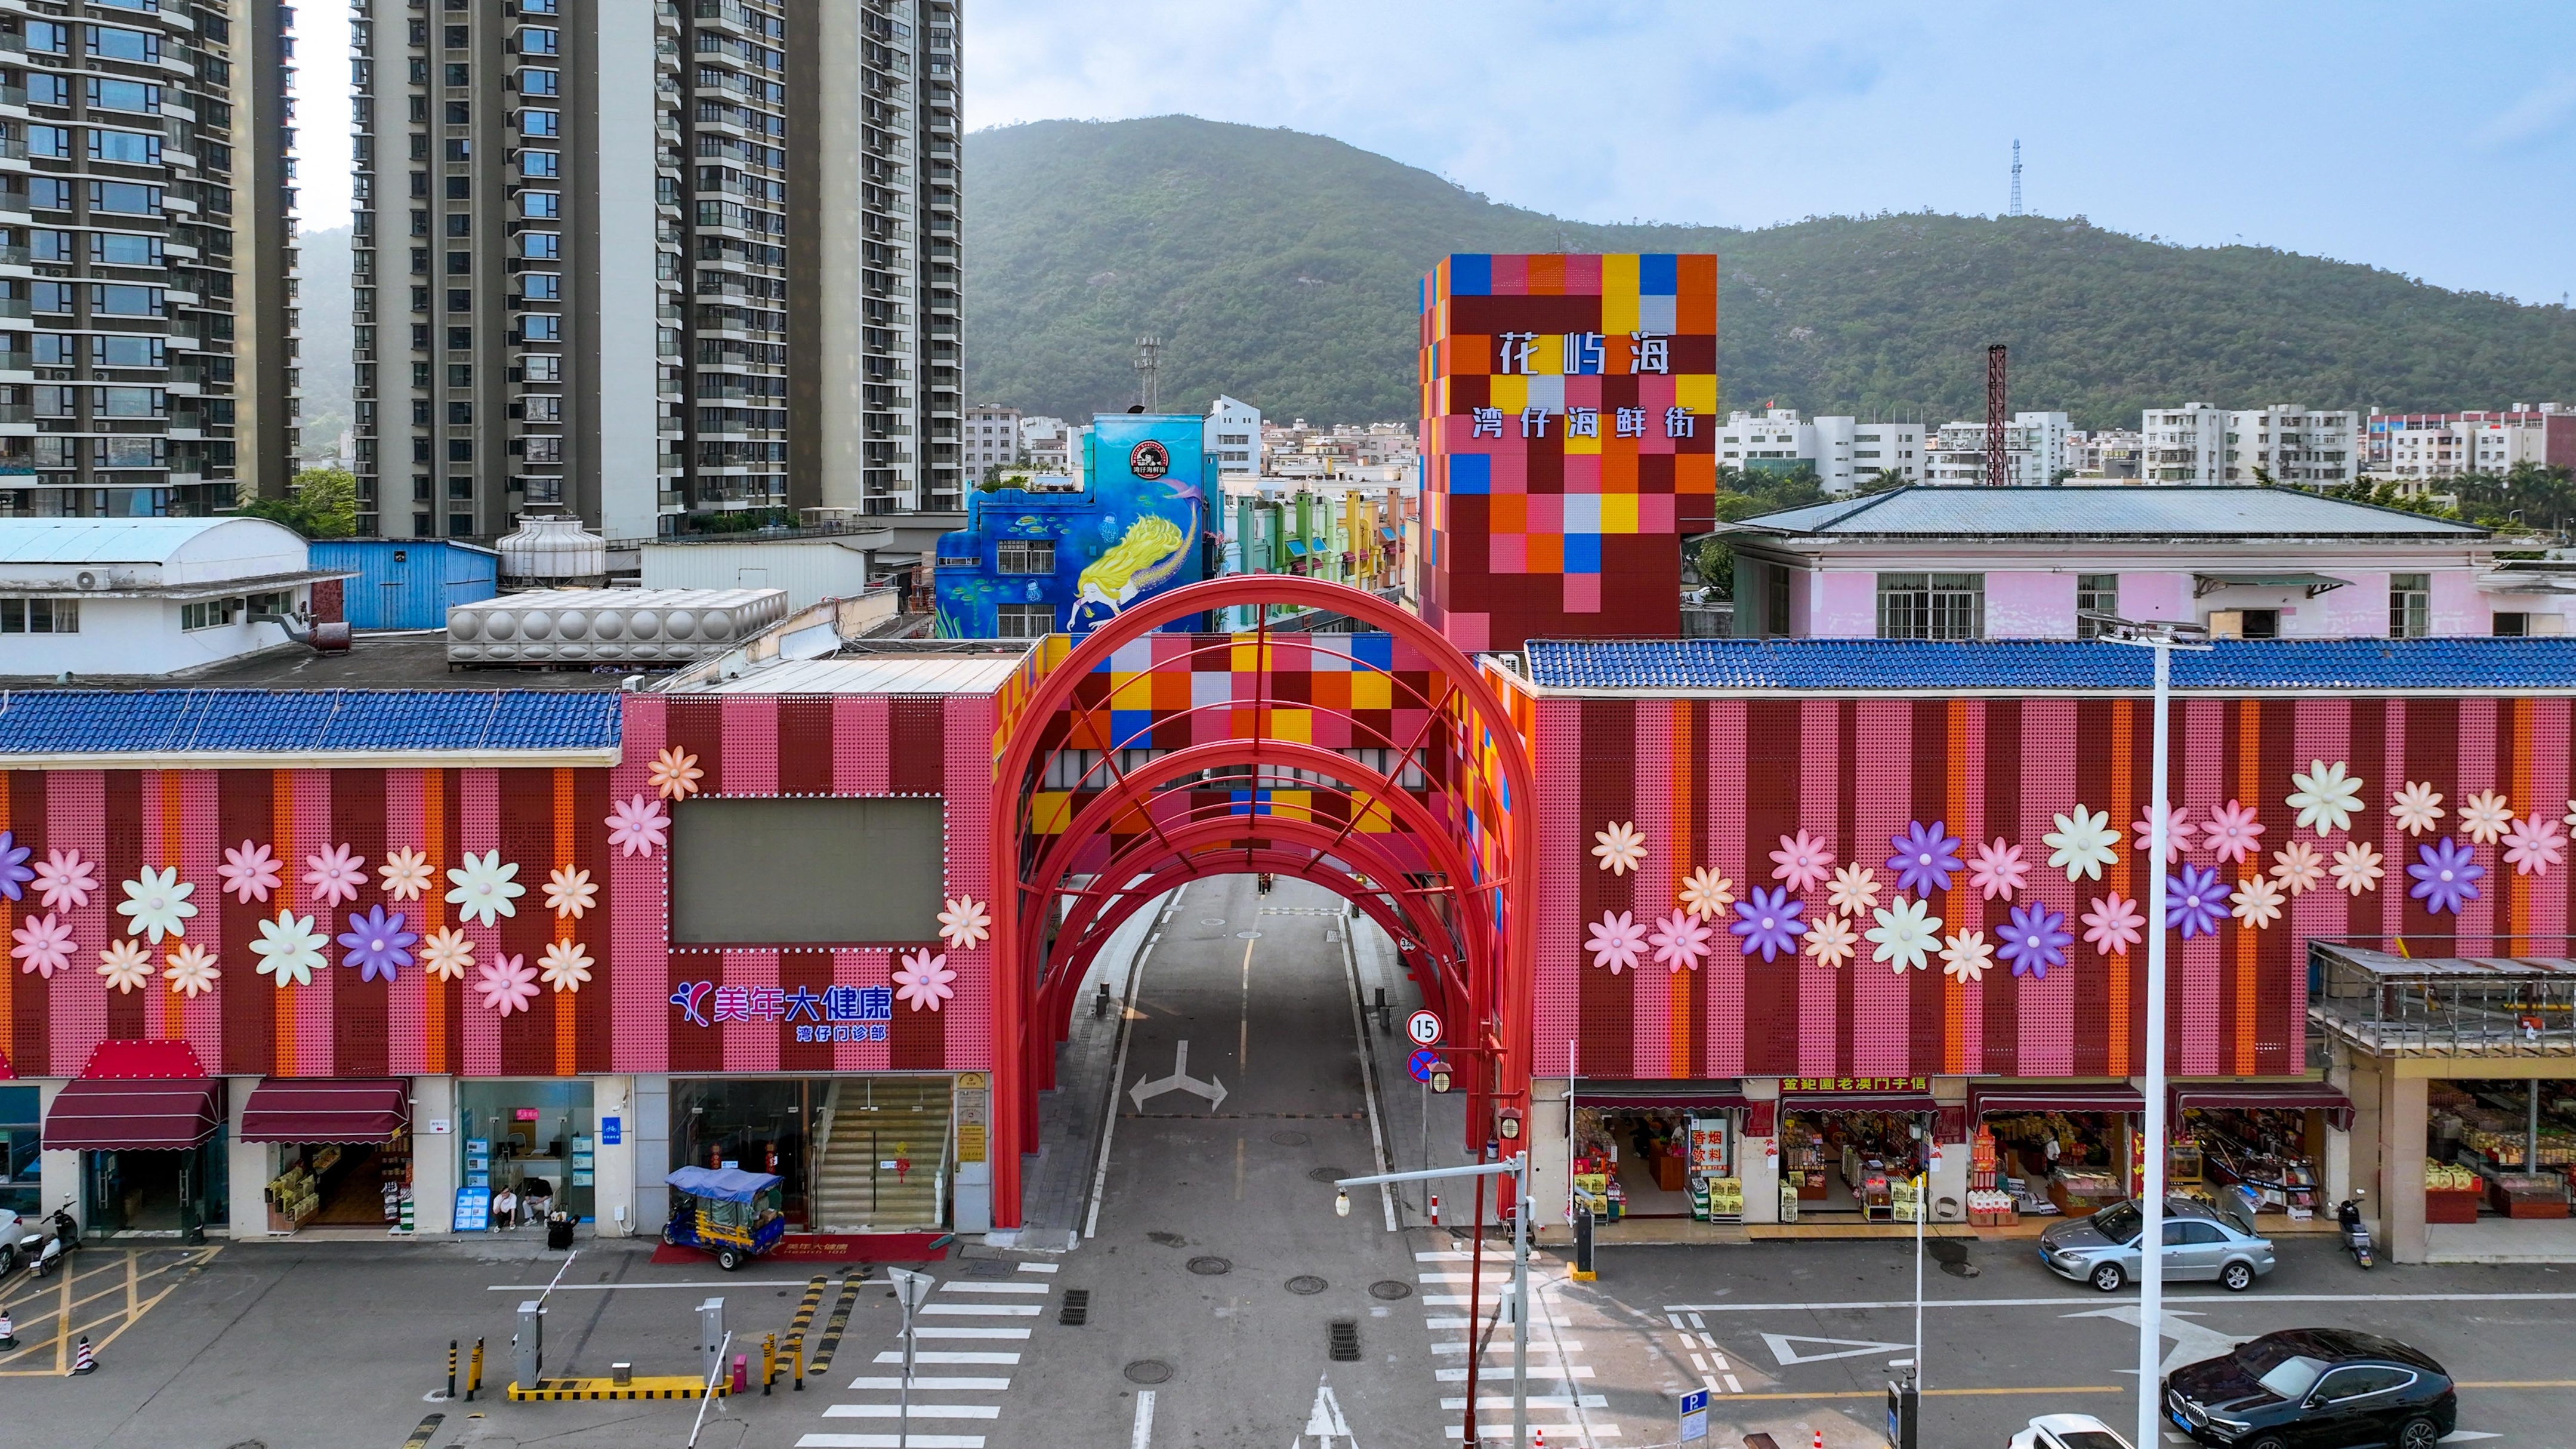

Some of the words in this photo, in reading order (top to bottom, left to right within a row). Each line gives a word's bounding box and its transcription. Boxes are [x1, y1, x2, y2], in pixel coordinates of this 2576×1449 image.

[1499, 331, 1669, 375] 花屿海
[1472, 406, 1695, 438] 湾仔海鲜街
[714, 985, 892, 1022] 美年大健康
[796, 1025, 887, 1043] 湾仔门诊部
[1417, 1020, 1434, 1038] 15
[1693, 1131, 1722, 1145] 香烟
[1692, 1148, 1722, 1163] 饮料
[1689, 1395, 1698, 1410] P
